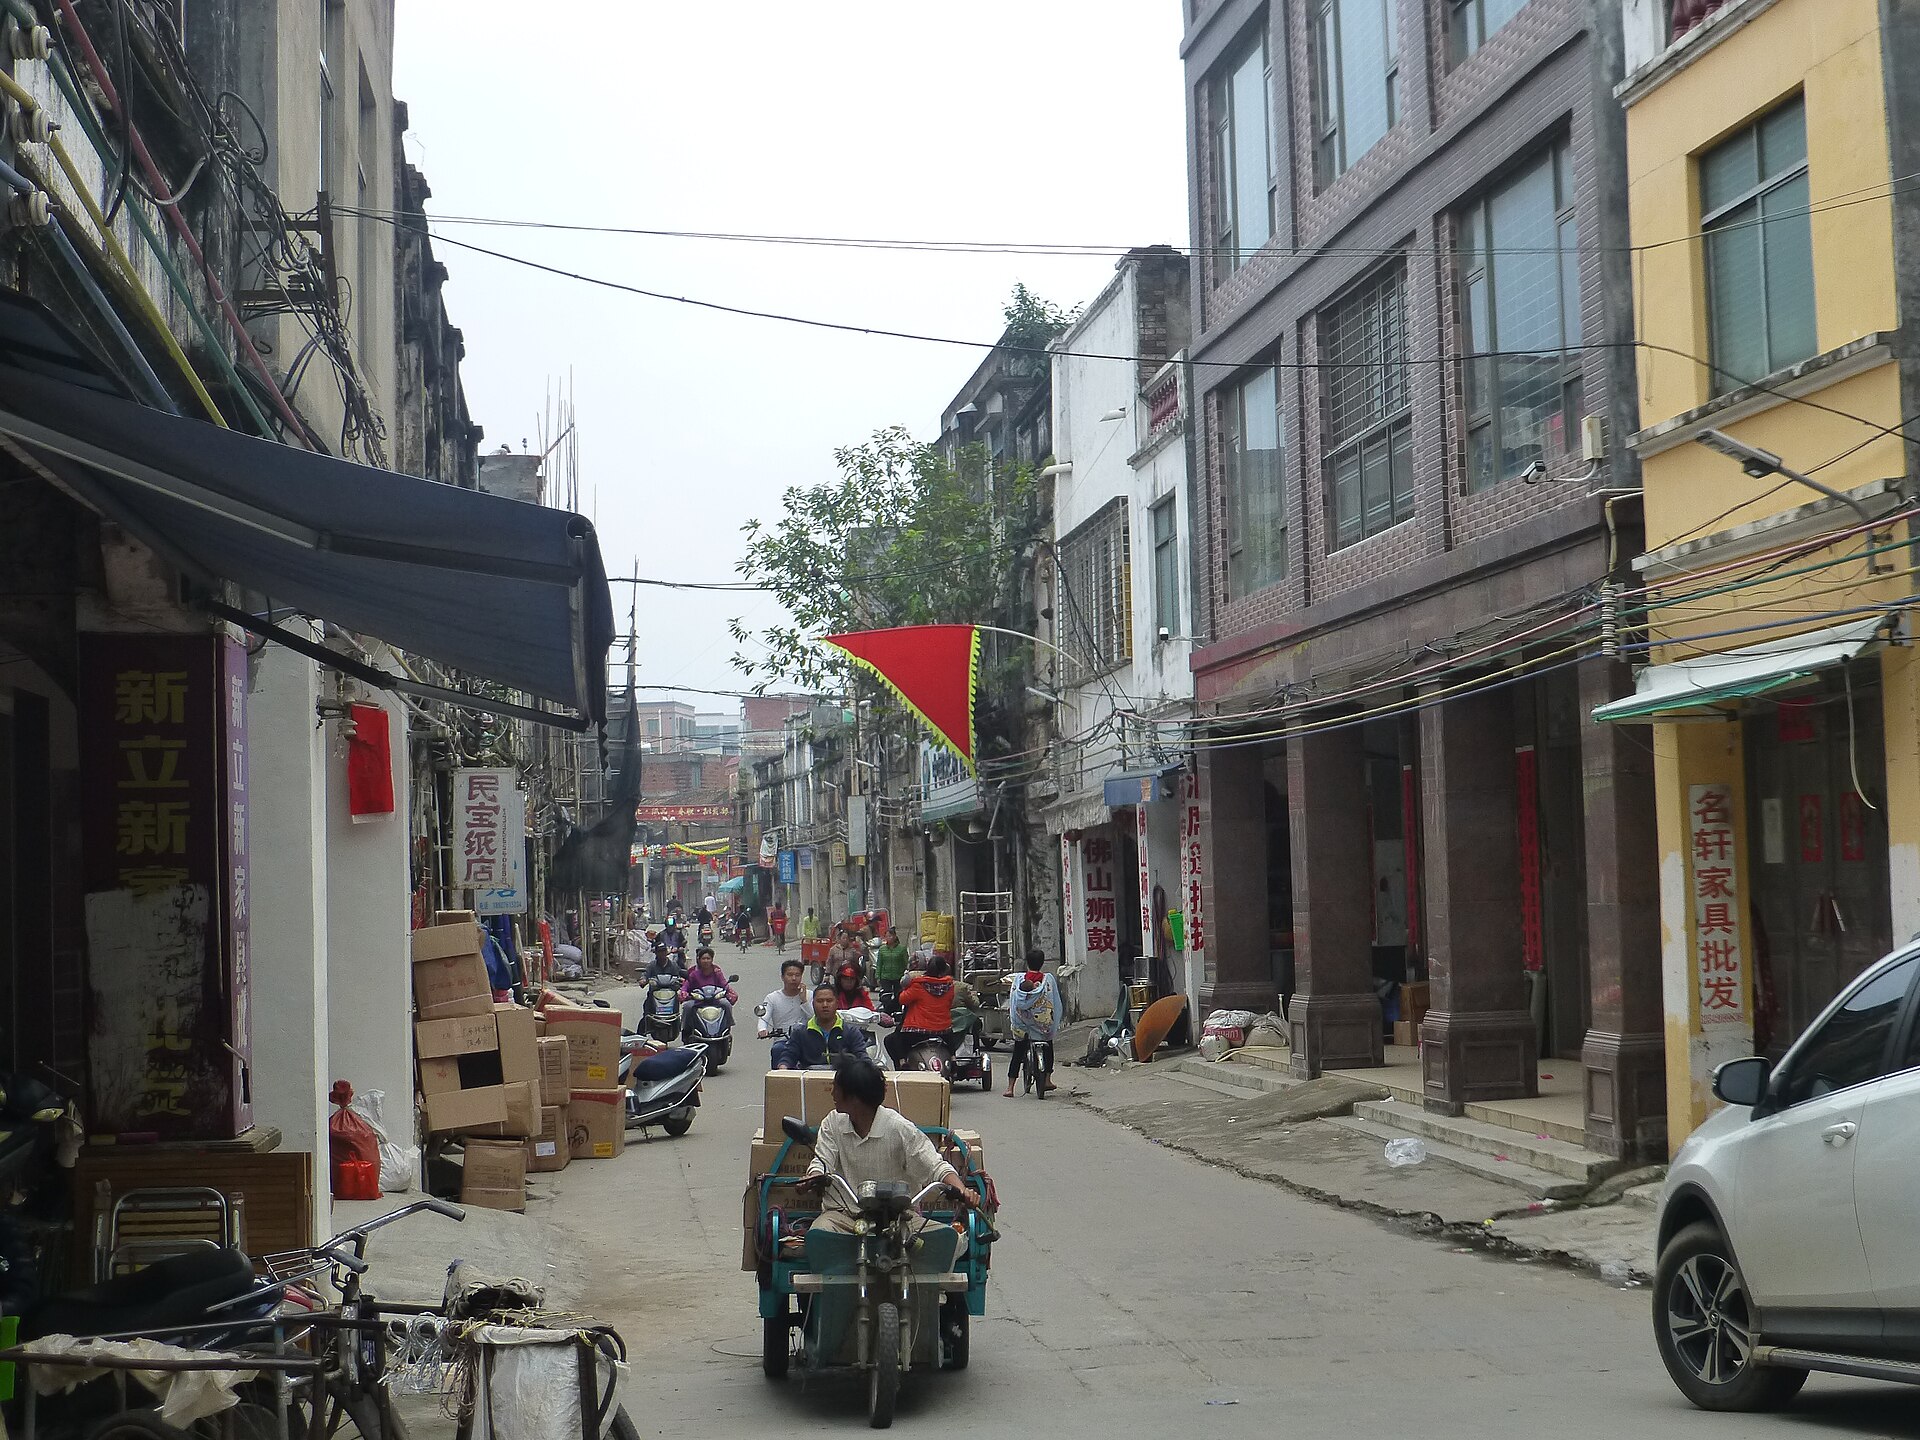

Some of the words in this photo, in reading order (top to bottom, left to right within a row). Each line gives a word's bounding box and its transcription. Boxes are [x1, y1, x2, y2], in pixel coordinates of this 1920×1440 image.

[464, 775, 500, 882] 民宝纸店
[1083, 838, 1117, 952] 佛山狮鼓
[1693, 790, 1739, 1010] 名轩家具批发
